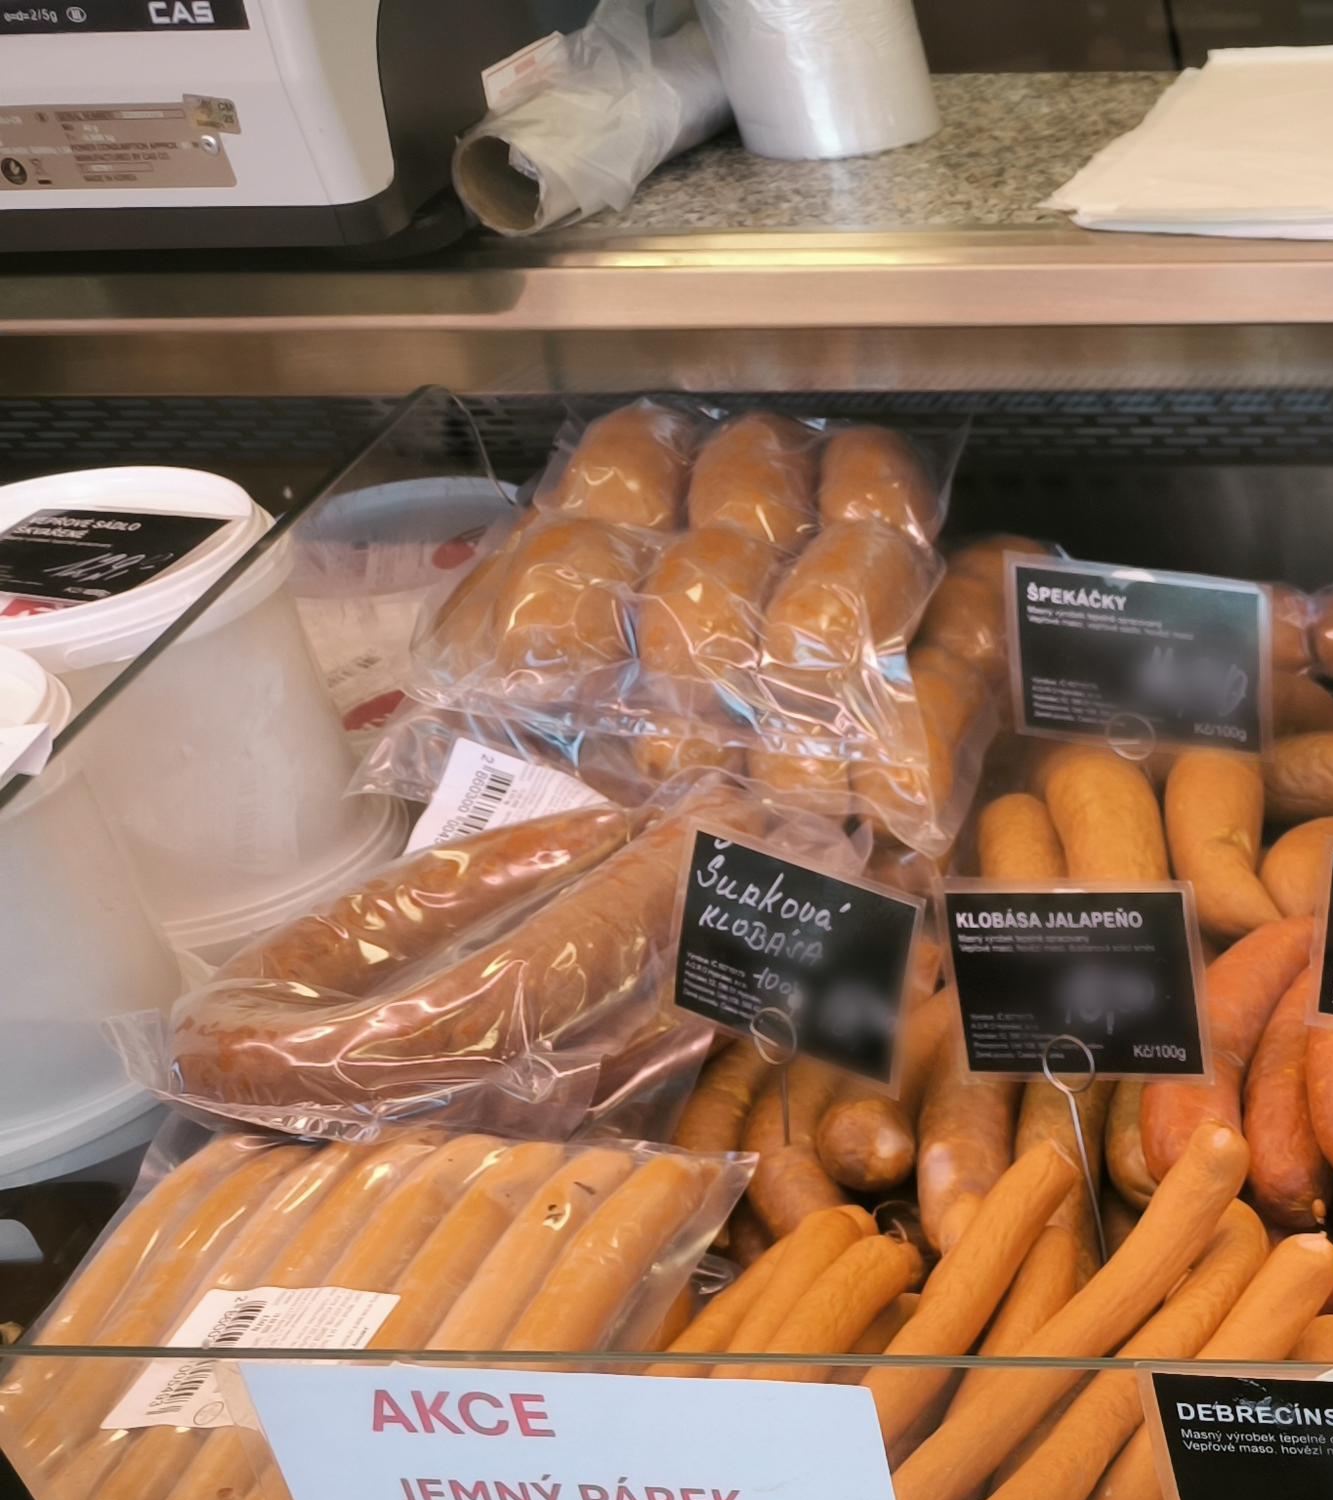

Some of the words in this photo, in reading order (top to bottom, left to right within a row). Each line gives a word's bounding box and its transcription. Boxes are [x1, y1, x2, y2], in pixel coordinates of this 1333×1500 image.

[148, 1, 215, 24] CAS
[93, 519, 142, 531] SÁDLO
[1026, 581, 1127, 611] ŠPEKÁČKY
[955, 908, 1042, 928] KLOBÁSA
[1045, 907, 1144, 928] JALAPEŇO
[1132, 1044, 1187, 1062] Kč/100g
[371, 1388, 557, 1439] AKCE
[1181, 1428, 1222, 1442] Masný
[1226, 1431, 1276, 1443] výrobek
[1279, 1433, 1326, 1446] tepelně
[1183, 1440, 1235, 1454] Vepřové
